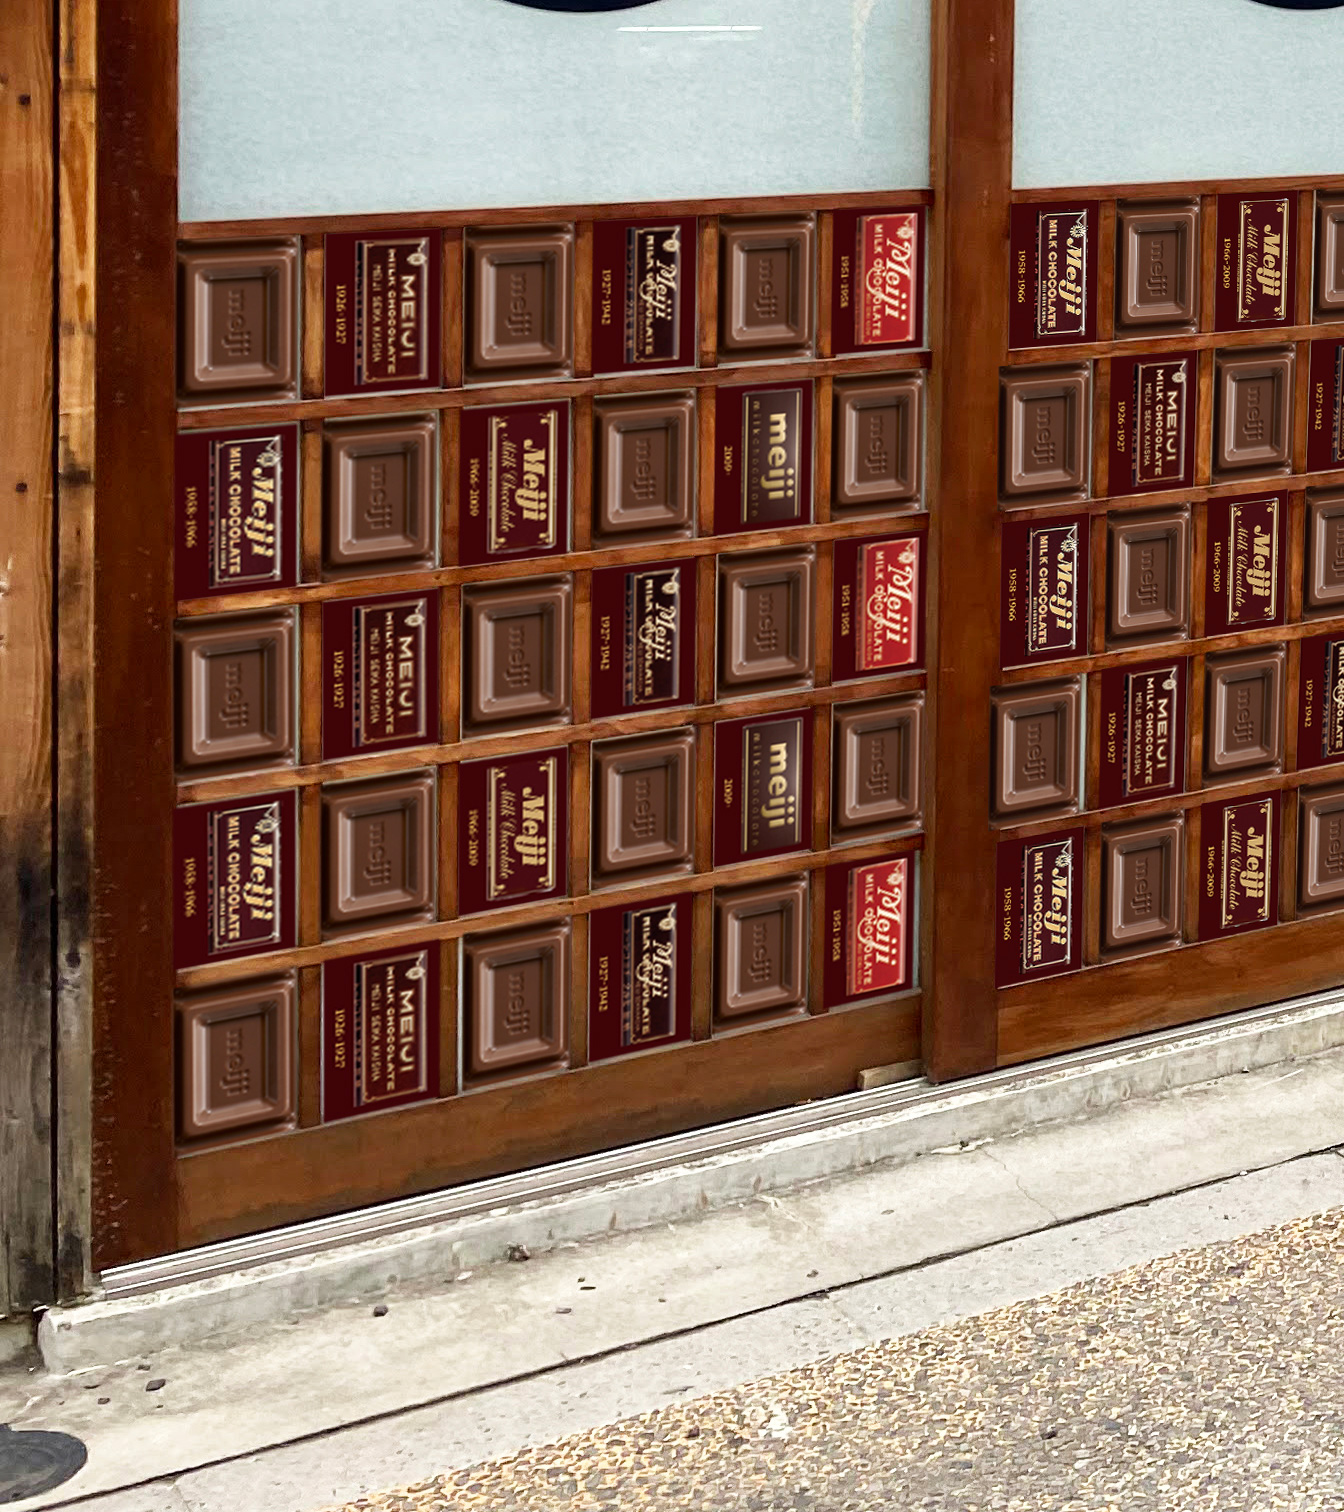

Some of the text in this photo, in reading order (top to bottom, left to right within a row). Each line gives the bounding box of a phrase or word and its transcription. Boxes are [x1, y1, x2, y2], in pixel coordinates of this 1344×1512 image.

[640, 260, 678, 322] Meiji
[866, 238, 911, 322] Meiji
[1018, 249, 1026, 304] 1958-1966
[1047, 218, 1058, 328] MILK CHOCOLATE
[1058, 238, 1082, 316] Meiji
[1222, 236, 1232, 288] 1966-2009
[1258, 224, 1281, 297] Meiji
[400, 274, 416, 358] MEIJI
[1116, 400, 1126, 453] 1926-1927
[1154, 368, 1164, 476] MILK CHOCOLATE
[1164, 390, 1178, 462] MEIJI
[1314, 382, 1324, 430] 1927-1942
[514, 440, 547, 522] Meiji
[760, 412, 794, 500] meiji
[244, 467, 275, 558] Meiji
[1008, 567, 1016, 622] 1958-1966
[1038, 535, 1048, 644] MILK CHOCOLATE
[1049, 552, 1073, 630] Meiji
[1213, 540, 1222, 592] 1966-2009
[1248, 524, 1271, 598] Meiji
[639, 602, 677, 663] Meiji
[867, 565, 913, 646] Meiji
[398, 636, 414, 716] MEIJI
[1304, 679, 1313, 728] 1927-1942
[1107, 711, 1117, 764] 1926-1927
[1145, 677, 1155, 785] MILK CHOCOLATE
[1155, 698, 1169, 769] MEIJI
[761, 743, 795, 828] meiji
[514, 787, 546, 867] Meiji
[1241, 826, 1264, 899] Meiji
[242, 834, 274, 922] Meiji
[1032, 851, 1043, 961] MILK CHOCOLATE
[1043, 868, 1068, 946] Meiji
[1206, 845, 1215, 897] 1966-2009
[857, 887, 901, 968] Meiji
[1003, 886, 1011, 941] 1958-1966
[636, 939, 674, 1000] Meiji
[399, 990, 415, 1072] MEIJI
